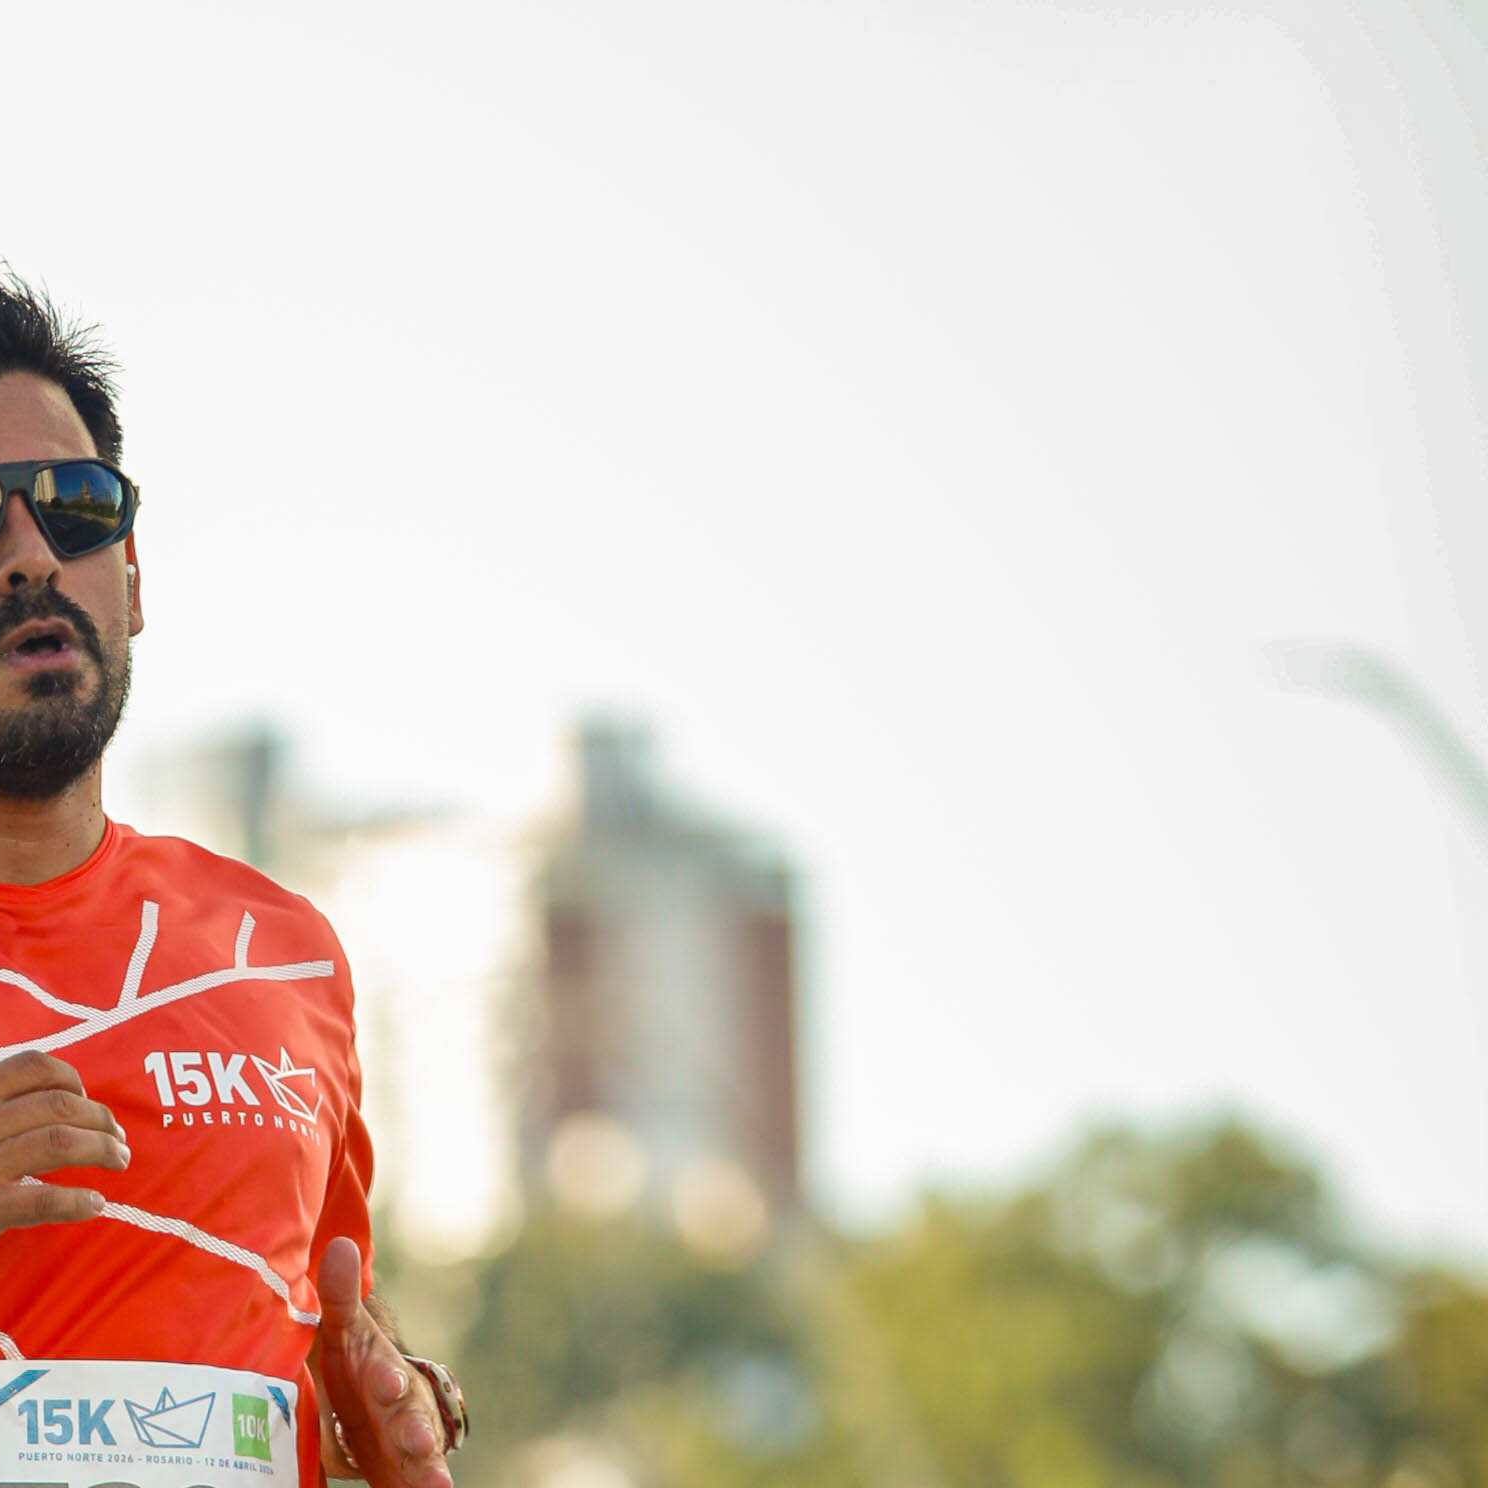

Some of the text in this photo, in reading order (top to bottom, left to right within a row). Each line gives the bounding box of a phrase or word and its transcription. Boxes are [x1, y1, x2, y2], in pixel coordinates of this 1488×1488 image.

[144, 1051, 261, 1107] 15K
[163, 1110, 321, 1146] PUERTO NORTE
[17, 1399, 117, 1446] 15K
[237, 1413, 267, 1443] 10K
[18, 1452, 63, 1461] PUERTO
[67, 1453, 104, 1462] NORTE
[107, 1454, 134, 1463] 2026
[146, 1455, 193, 1465] ROSARIO
[204, 1457, 215, 1467] 12
[218, 1458, 230, 1468] DE
[233, 1460, 257, 1472] ABRIL
